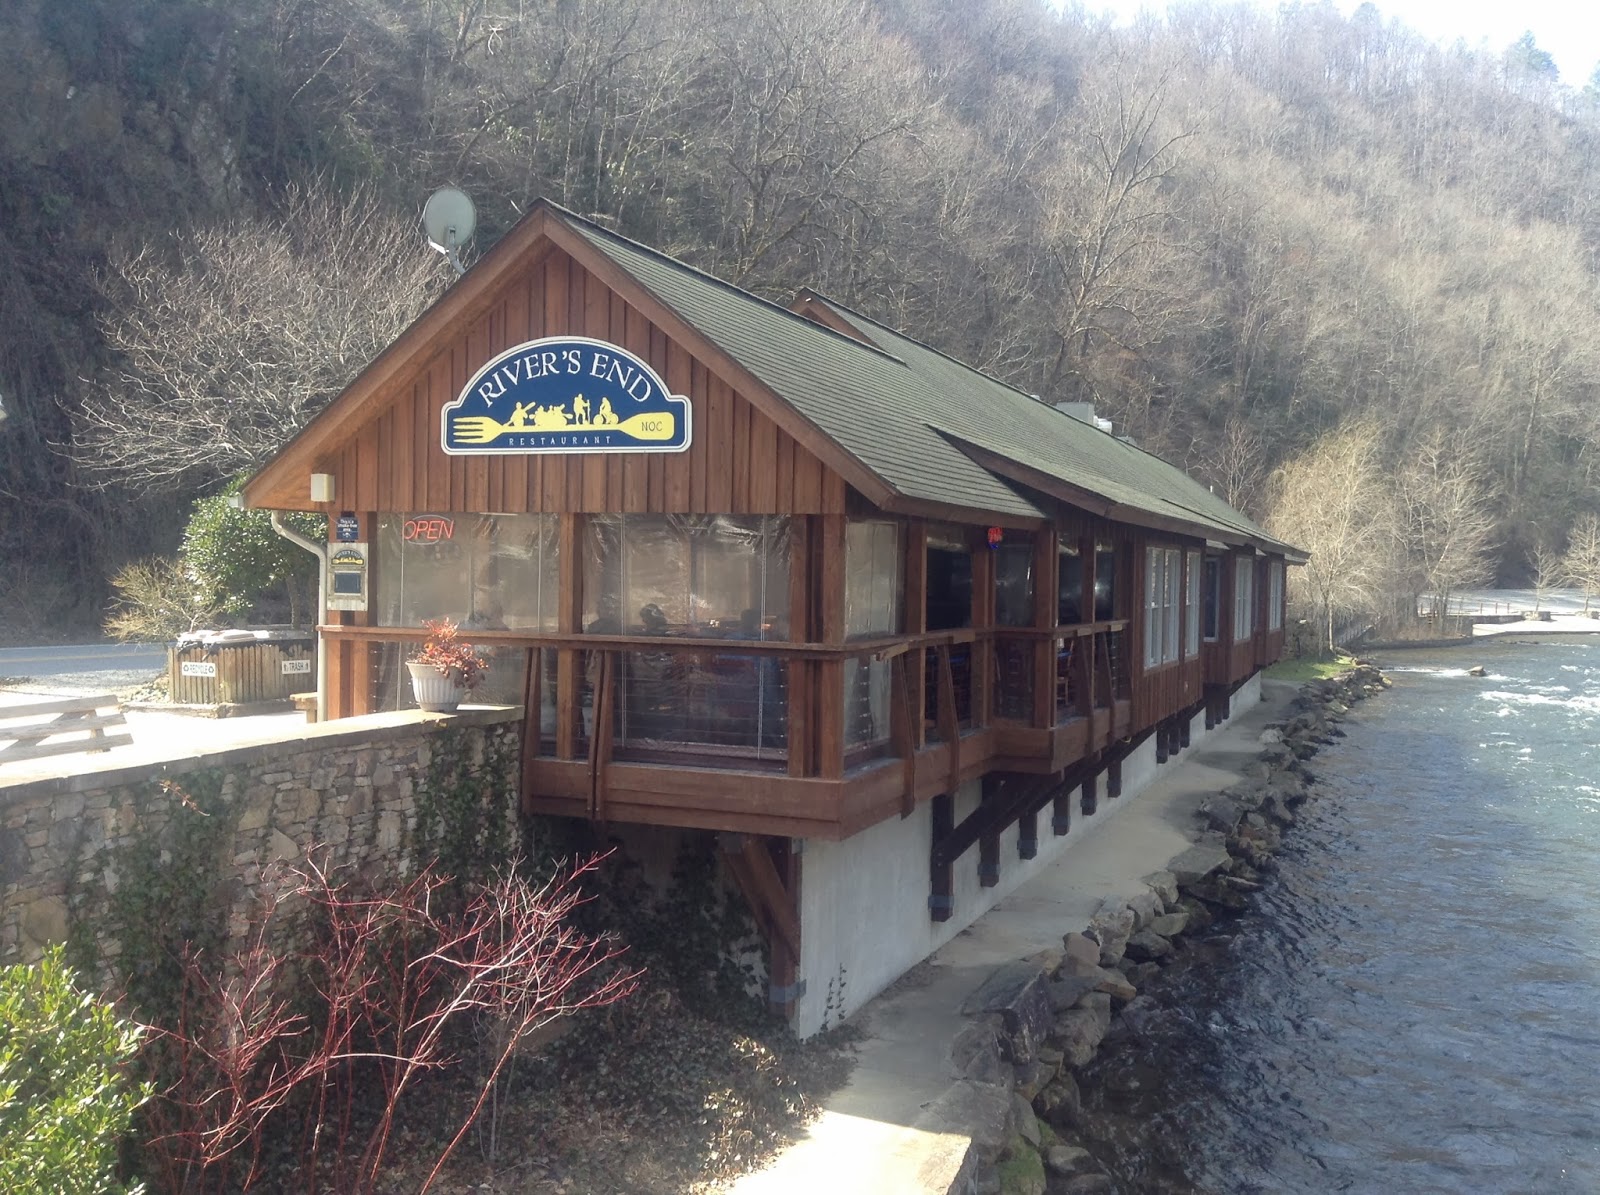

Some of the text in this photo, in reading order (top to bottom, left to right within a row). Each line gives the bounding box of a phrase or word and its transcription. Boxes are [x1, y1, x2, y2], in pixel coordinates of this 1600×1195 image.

[478, 350, 652, 407] RIVER'S END
[641, 421, 663, 432] NOC
[508, 435, 612, 446] RESTAURANT
[403, 520, 454, 540] OPEN
[190, 664, 208, 674] RECYCLE
[289, 661, 304, 672] TRASH
